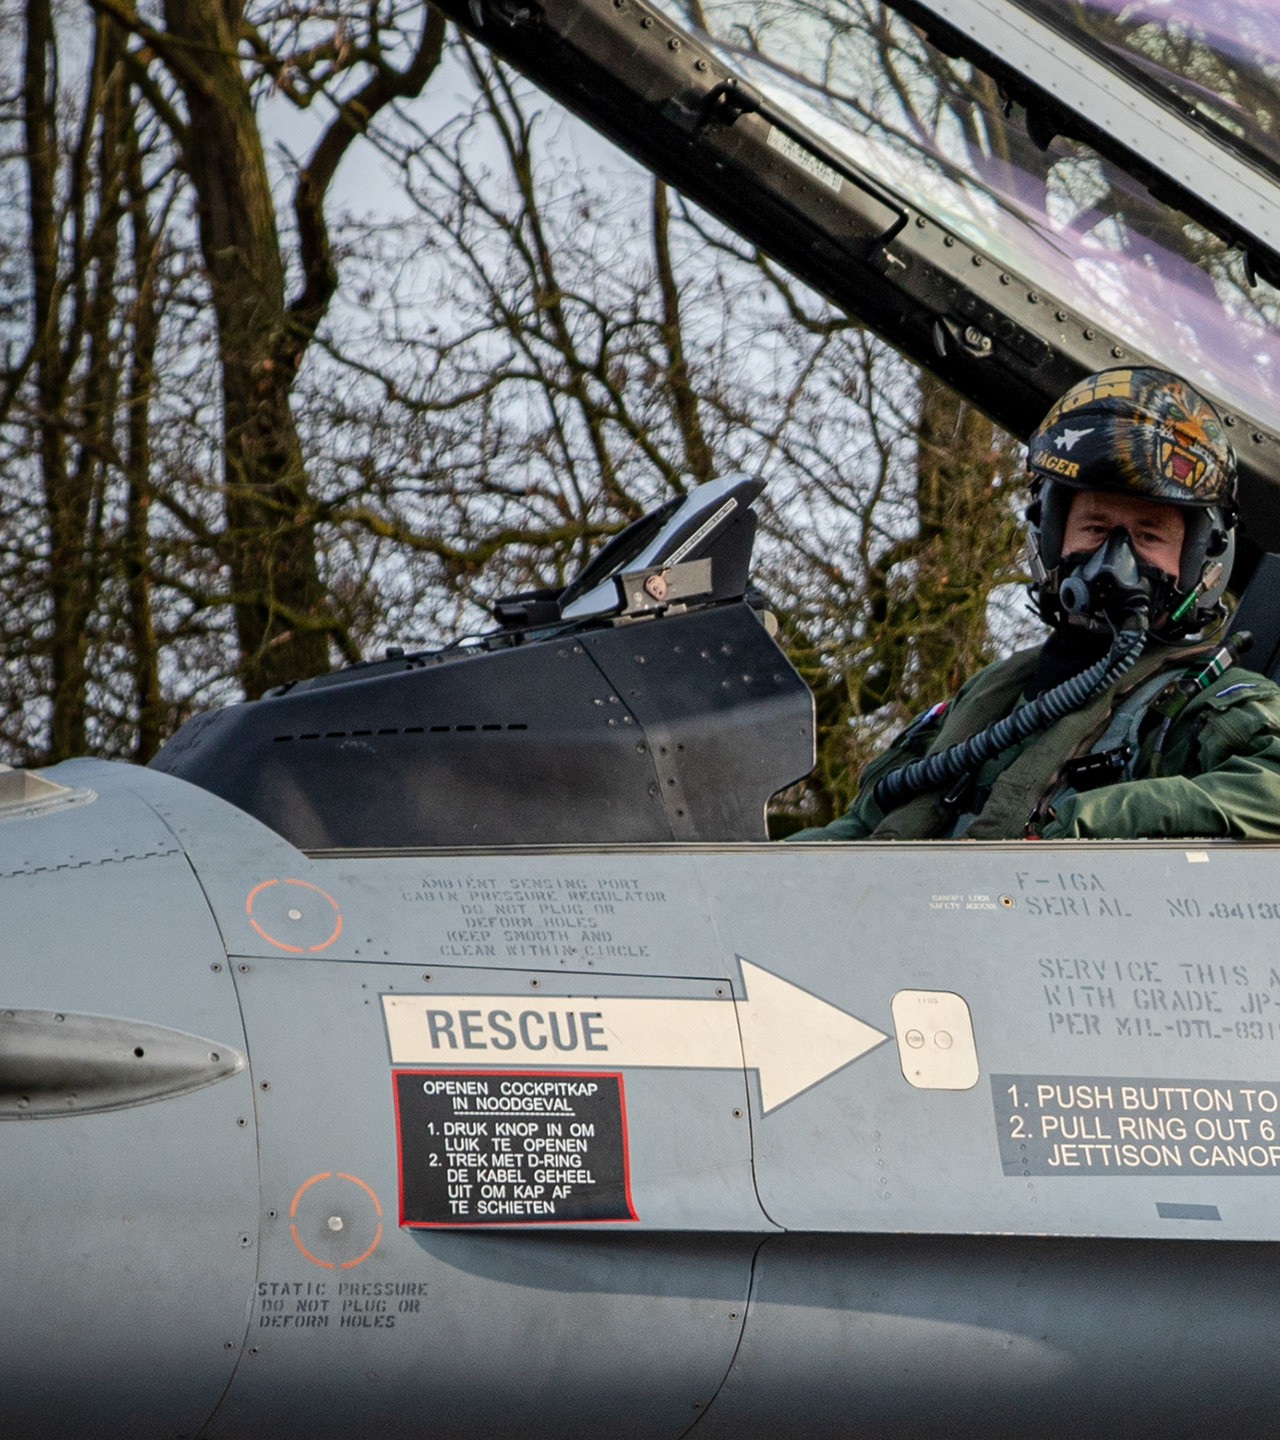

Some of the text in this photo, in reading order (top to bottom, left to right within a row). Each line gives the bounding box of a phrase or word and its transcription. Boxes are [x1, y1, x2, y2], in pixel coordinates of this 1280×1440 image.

[421, 878, 640, 890] AMBIENT SENSING PORT
[1015, 871, 1105, 891] F-16A
[401, 891, 667, 902] CABIN PRESSURE REGULATOR
[461, 904, 616, 915] DO NOT PLUG OR
[1025, 897, 1132, 916] SERIAL
[465, 917, 599, 928] DEFORM HOLES
[446, 931, 613, 942] KEEP SMOOTH AND
[439, 944, 651, 957] CLEAN WITHIN CIRCLE
[1038, 958, 1162, 982] SERVICE
[1179, 963, 1249, 986] THIS
[1043, 985, 1116, 1008] WITH
[1133, 988, 1222, 1012] GRADE
[425, 1009, 609, 1051] RESCUE
[1048, 1012, 1101, 1035] PER
[423, 1081, 598, 1097] OPENEN COCKPITKAP
[452, 1097, 573, 1111] IN NOODGEVAL
[1007, 1085, 1029, 1108] 1.
[1037, 1085, 1113, 1109] PUSH
[1122, 1087, 1232, 1112] BUTTON
[1240, 1089, 1278, 1113] TO
[427, 1122, 595, 1137] 1. DRUK KNOP IN OM
[1010, 1115, 1033, 1139] 2.
[1041, 1116, 1112, 1139] PULL
[1118, 1117, 1187, 1140] RING
[1194, 1118, 1250, 1142] OUT
[1259, 1120, 1275, 1142] 6
[445, 1138, 588, 1153] LUIK TE OPENEN
[428, 1153, 582, 1168] 2. TREK MET D-RING
[1047, 1144, 1183, 1168] JETTISON
[447, 1169, 596, 1184] DE KABEL GEHEEL
[448, 1185, 572, 1198] UIT OM KAP AF
[449, 1200, 555, 1214] TE SCHIETEN
[258, 1282, 429, 1296] STATIC PRESSURE
[262, 1299, 421, 1313] DO NOT PLUG OR
[259, 1315, 396, 1328] DEFORM HOLES
